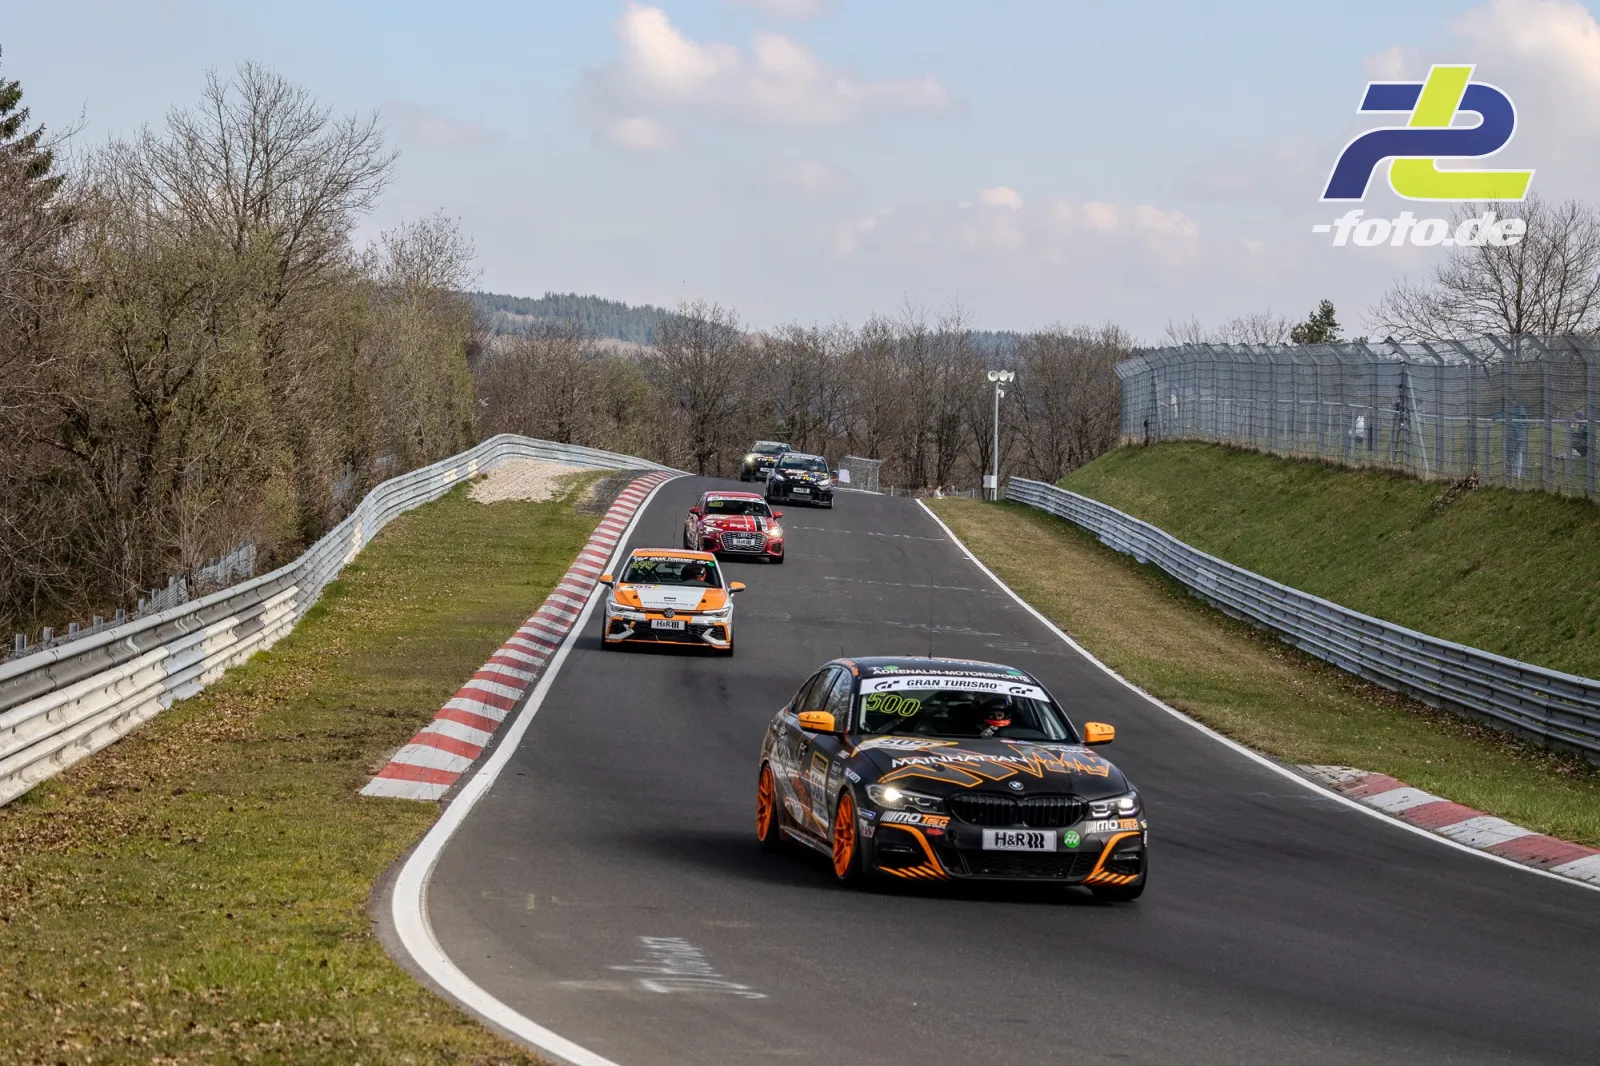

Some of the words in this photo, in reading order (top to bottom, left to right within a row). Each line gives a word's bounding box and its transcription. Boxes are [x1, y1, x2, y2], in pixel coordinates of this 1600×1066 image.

[656, 620, 671, 628] H&R
[906, 679, 940, 687] GRAN
[865, 692, 921, 717] 500
[892, 754, 1029, 769] MAINHATTAN
[994, 832, 1026, 847] H&R
